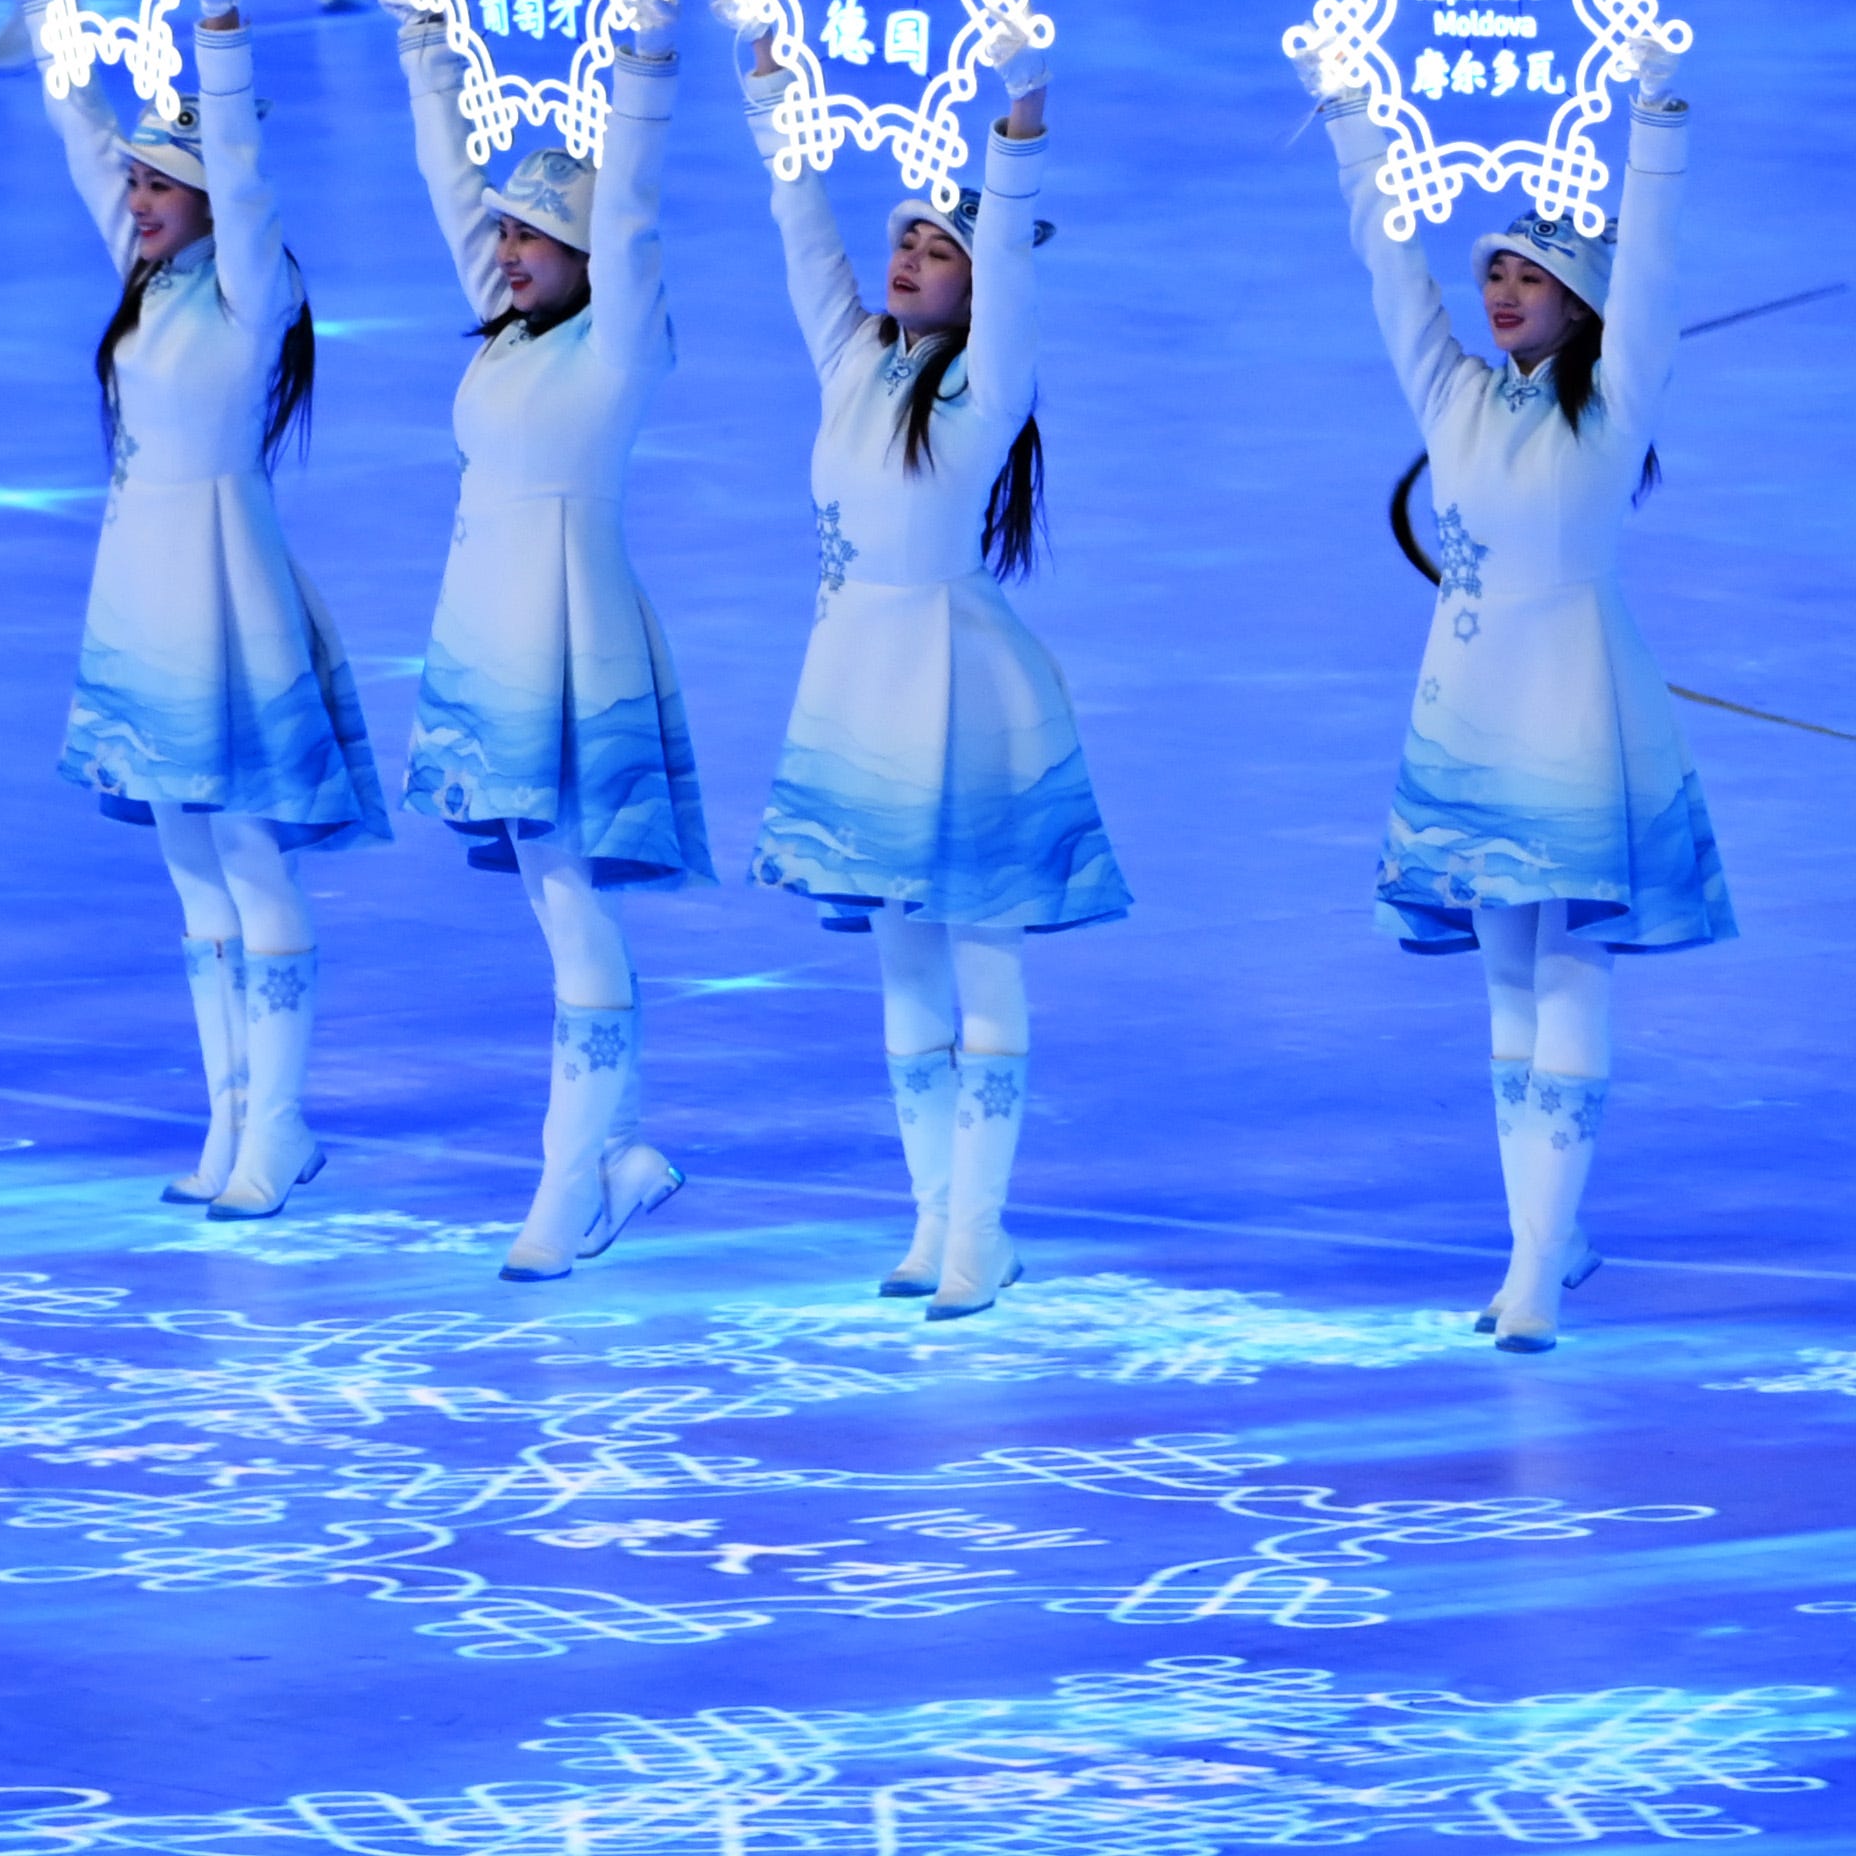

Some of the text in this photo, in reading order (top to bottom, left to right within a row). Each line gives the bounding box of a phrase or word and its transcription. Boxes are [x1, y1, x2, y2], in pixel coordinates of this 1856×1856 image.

[1433, 9, 1538, 39] Moldova
[1411, 48, 1567, 100] 摩尔多瓦
